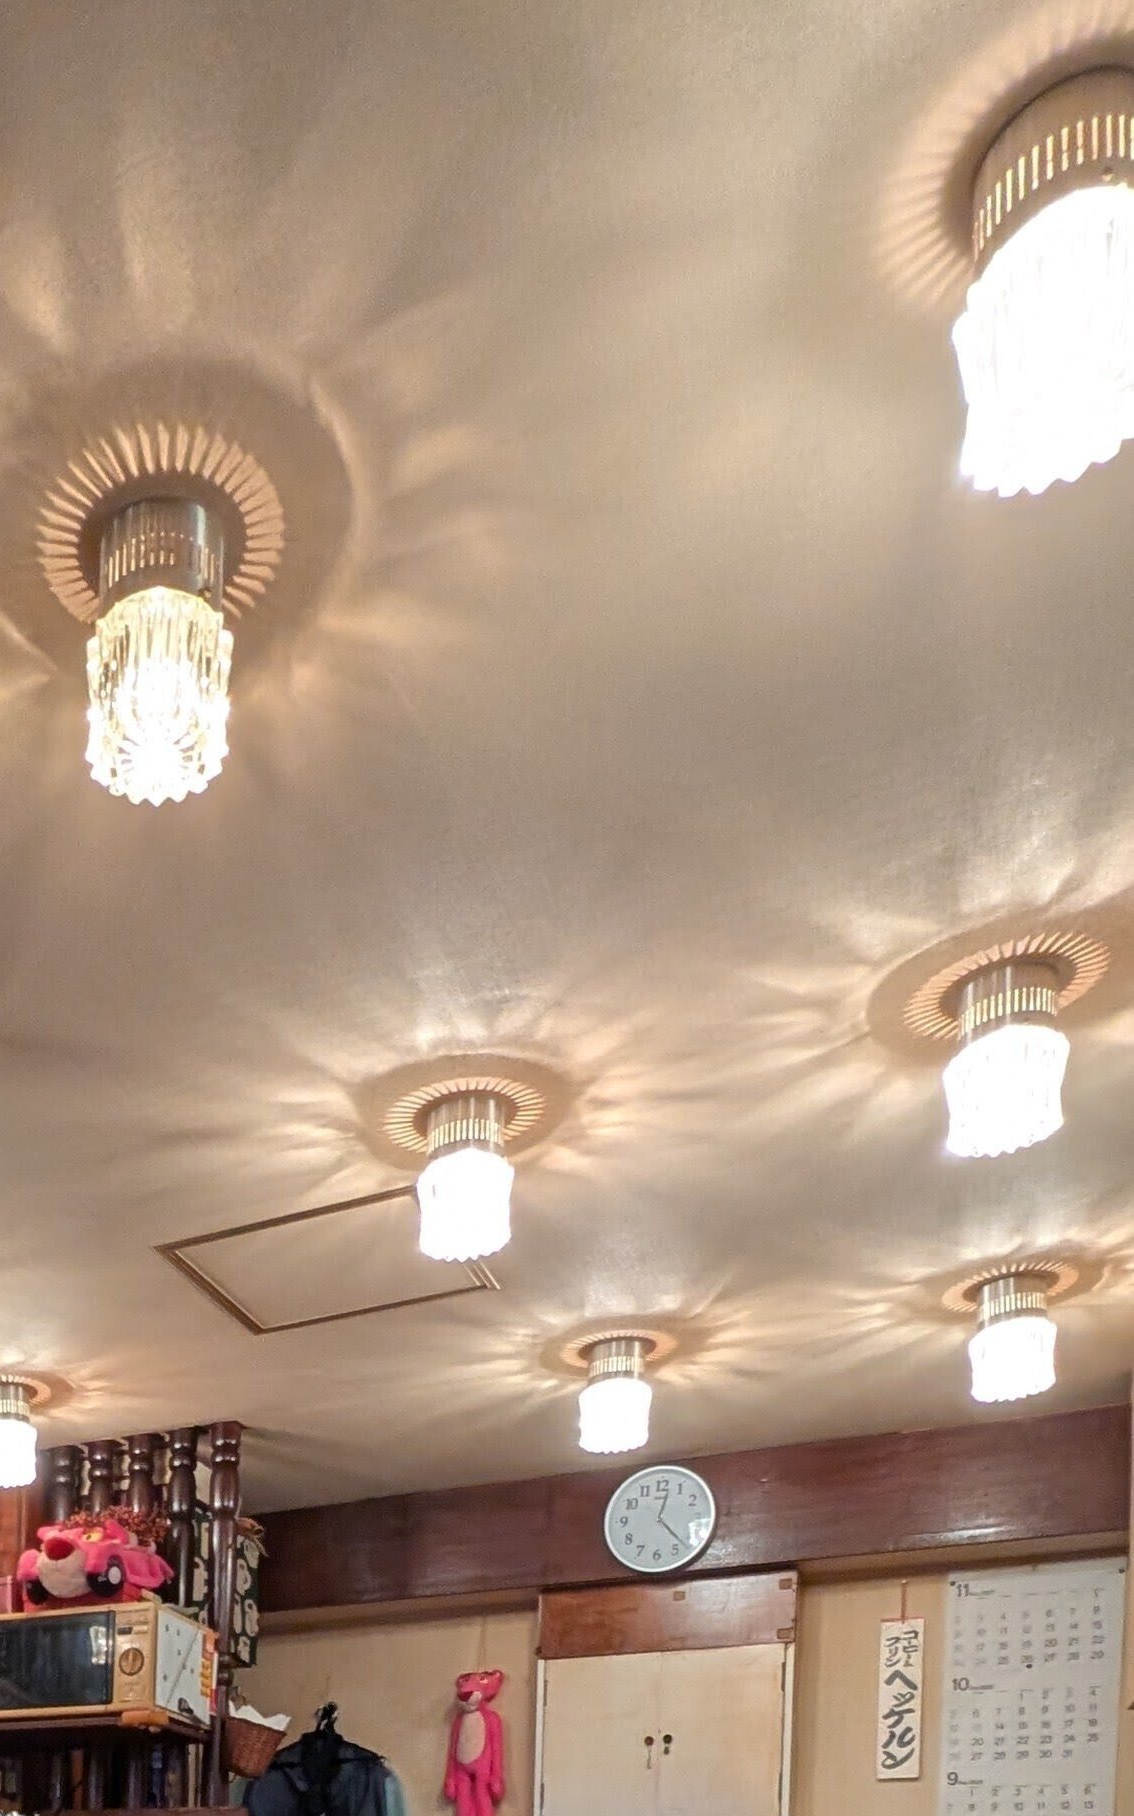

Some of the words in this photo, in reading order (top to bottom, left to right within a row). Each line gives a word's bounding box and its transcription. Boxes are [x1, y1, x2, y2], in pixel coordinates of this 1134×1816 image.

[640, 1485, 650, 1497] 11
[656, 1480, 669, 1492] 12
[677, 1483, 683, 1495] 1
[626, 1498, 638, 1510] 10
[688, 1495, 697, 1507] 2
[620, 1516, 628, 1528] 9
[625, 1533, 633, 1545] 8
[636, 1545, 645, 1557] 7
[653, 1549, 661, 1560] 6
[671, 1544, 679, 1556] 5
[956, 1584, 970, 1597] 11
[952, 1677, 969, 1691] 10
[881, 1669, 919, 1770] ヘッケルン
[947, 1772, 959, 1785] 9
